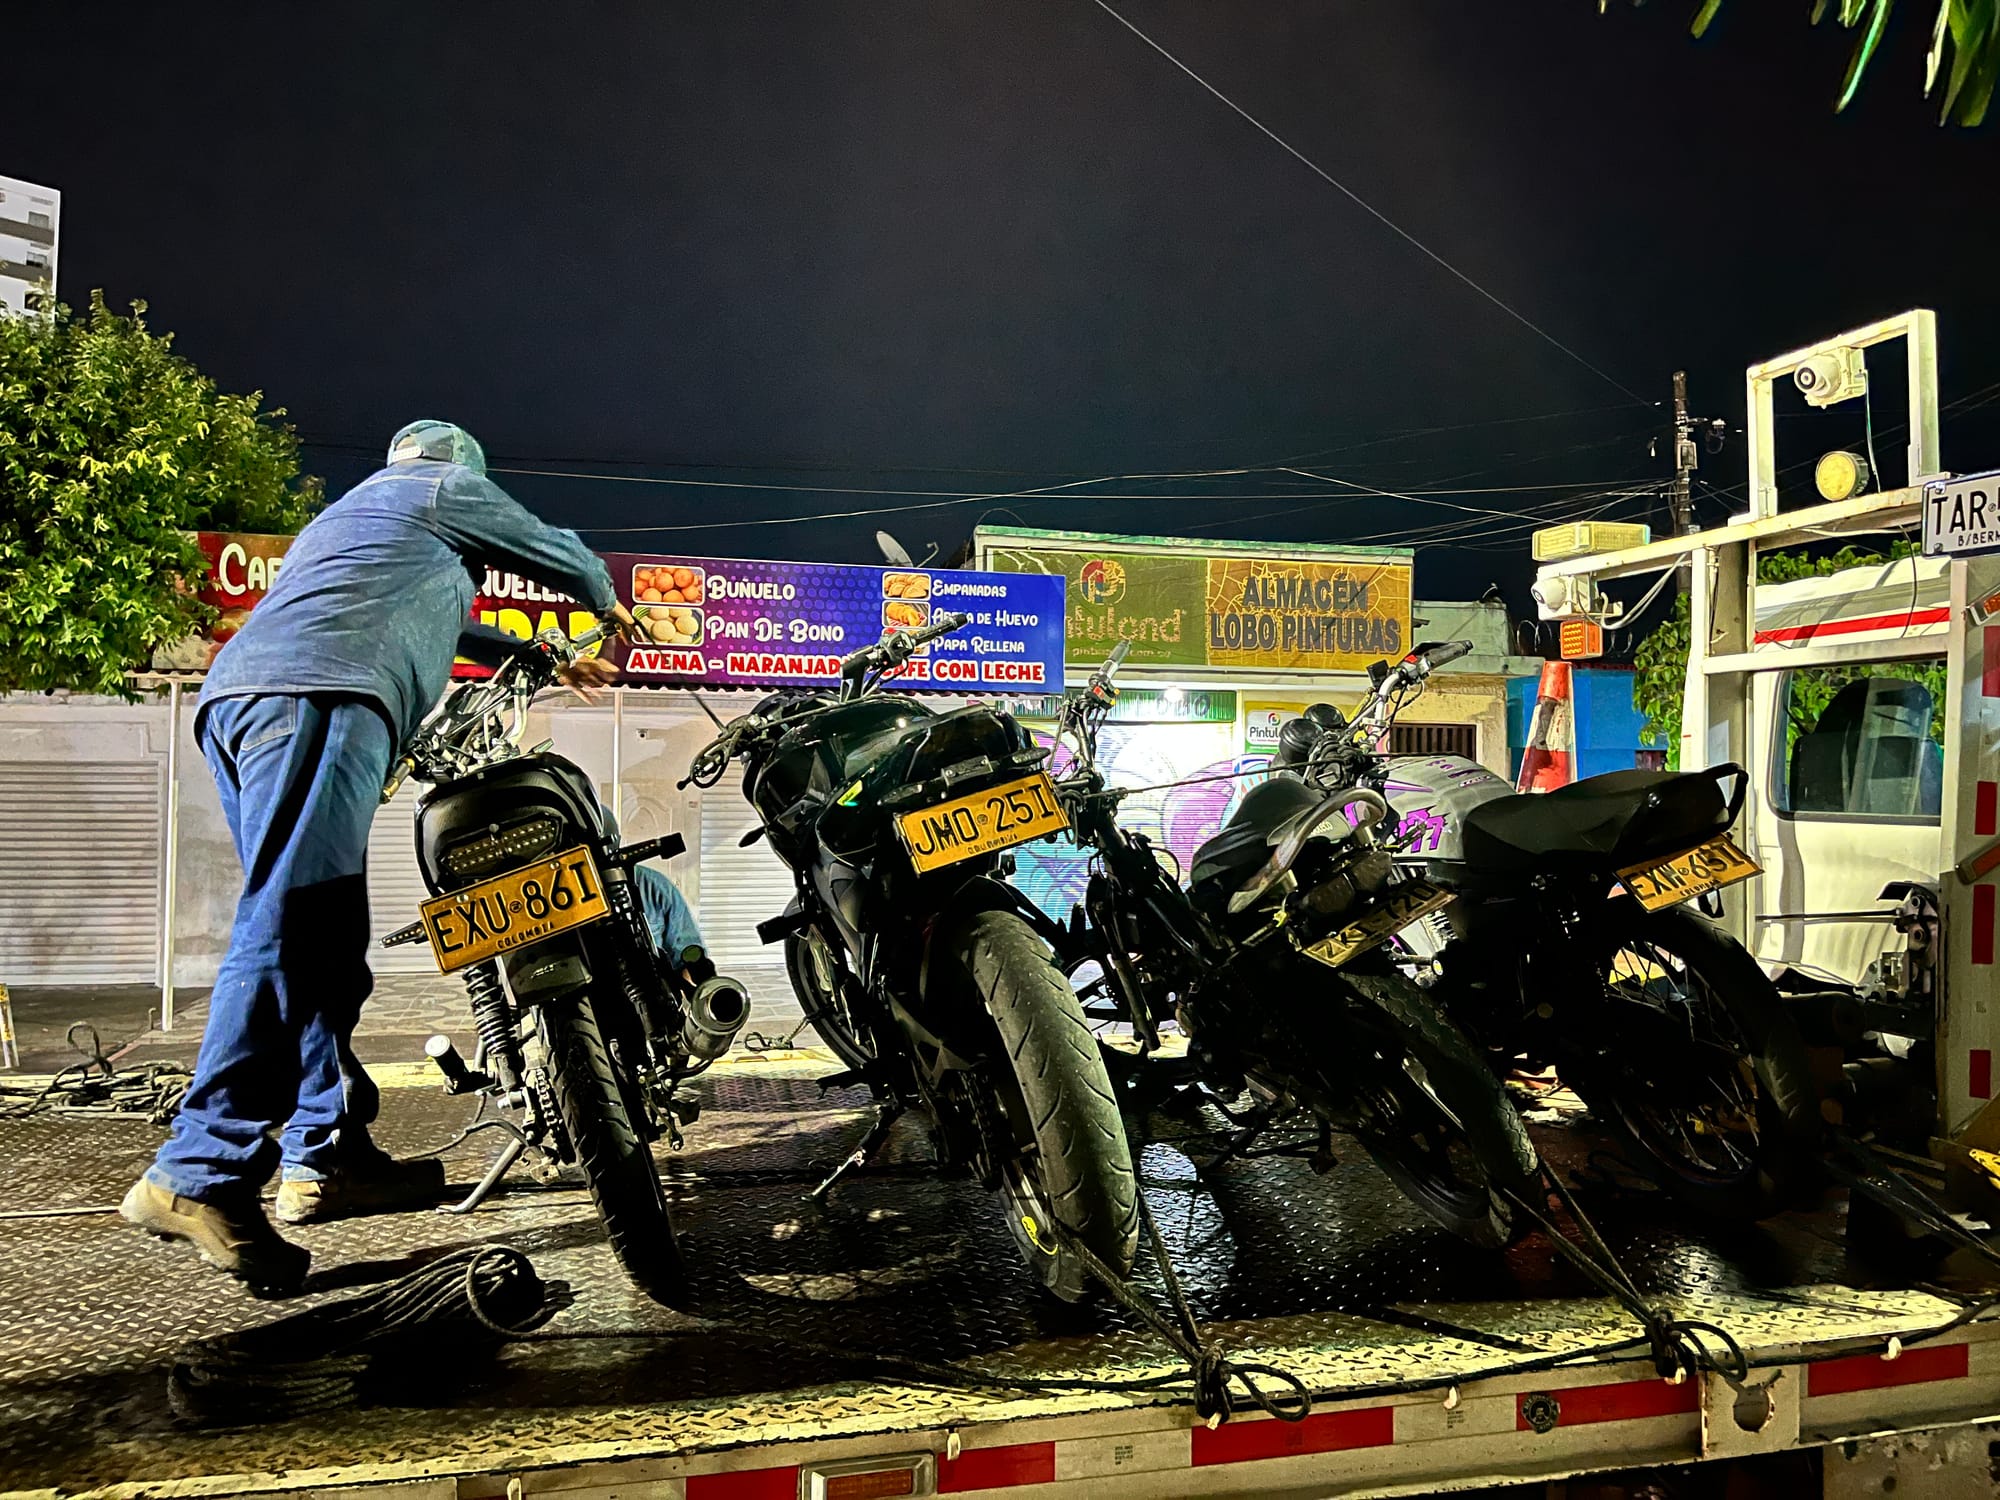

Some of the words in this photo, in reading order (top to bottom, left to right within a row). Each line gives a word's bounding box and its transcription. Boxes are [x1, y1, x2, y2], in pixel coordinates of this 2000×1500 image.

[1931, 490, 1987, 535] TAR
[707, 574, 796, 600] BUÑUELO
[932, 579, 1007, 597] EMPANADAS
[1242, 573, 1369, 612] ALMACÉN
[706, 615, 749, 640] PAN
[754, 617, 783, 642] DE
[788, 618, 845, 643] BONO
[977, 612, 991, 625] DE
[995, 610, 1038, 627] HUEVO
[931, 636, 968, 652] PAPA
[971, 636, 1025, 654] RELLENA
[1210, 612, 1277, 650] LOBO
[1282, 614, 1401, 654] PINTURAS
[629, 651, 704, 672] AVENA
[729, 654, 848, 676] NARANJAD
[934, 661, 977, 680] CON
[983, 663, 1044, 681] LECHE
[1249, 726, 1279, 738] Pintul
[496, 921, 554, 949] COLOMBIA
